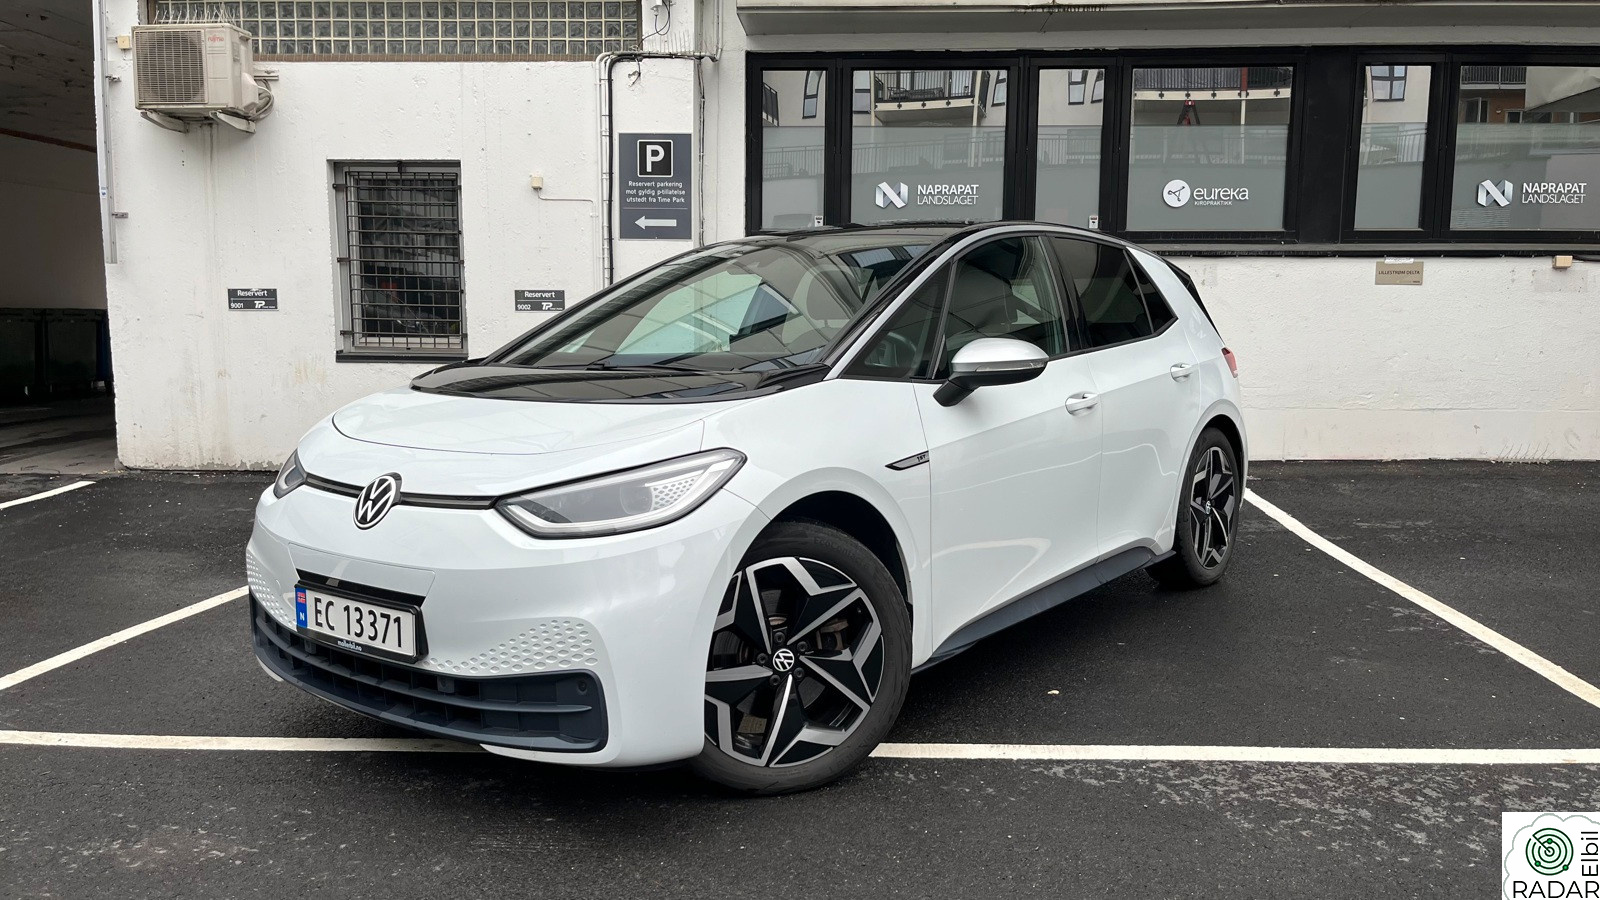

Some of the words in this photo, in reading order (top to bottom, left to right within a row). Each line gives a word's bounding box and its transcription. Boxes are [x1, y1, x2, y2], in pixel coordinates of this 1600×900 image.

[646, 144, 665, 172] P
[656, 181, 683, 189] parkering
[917, 184, 980, 195] NAPRAPAT
[1522, 182, 1587, 194] NAPRAPAT
[1193, 187, 1249, 200] eureka
[1521, 193, 1587, 204] LANDSLAGET
[917, 195, 979, 205] LANDSLAGET
[237, 289, 268, 297] Reservert
[254, 300, 266, 309] TP
[541, 302, 553, 310] TP
[299, 611, 305, 621] N
[313, 597, 336, 631] EC
[343, 604, 402, 648] 13371
